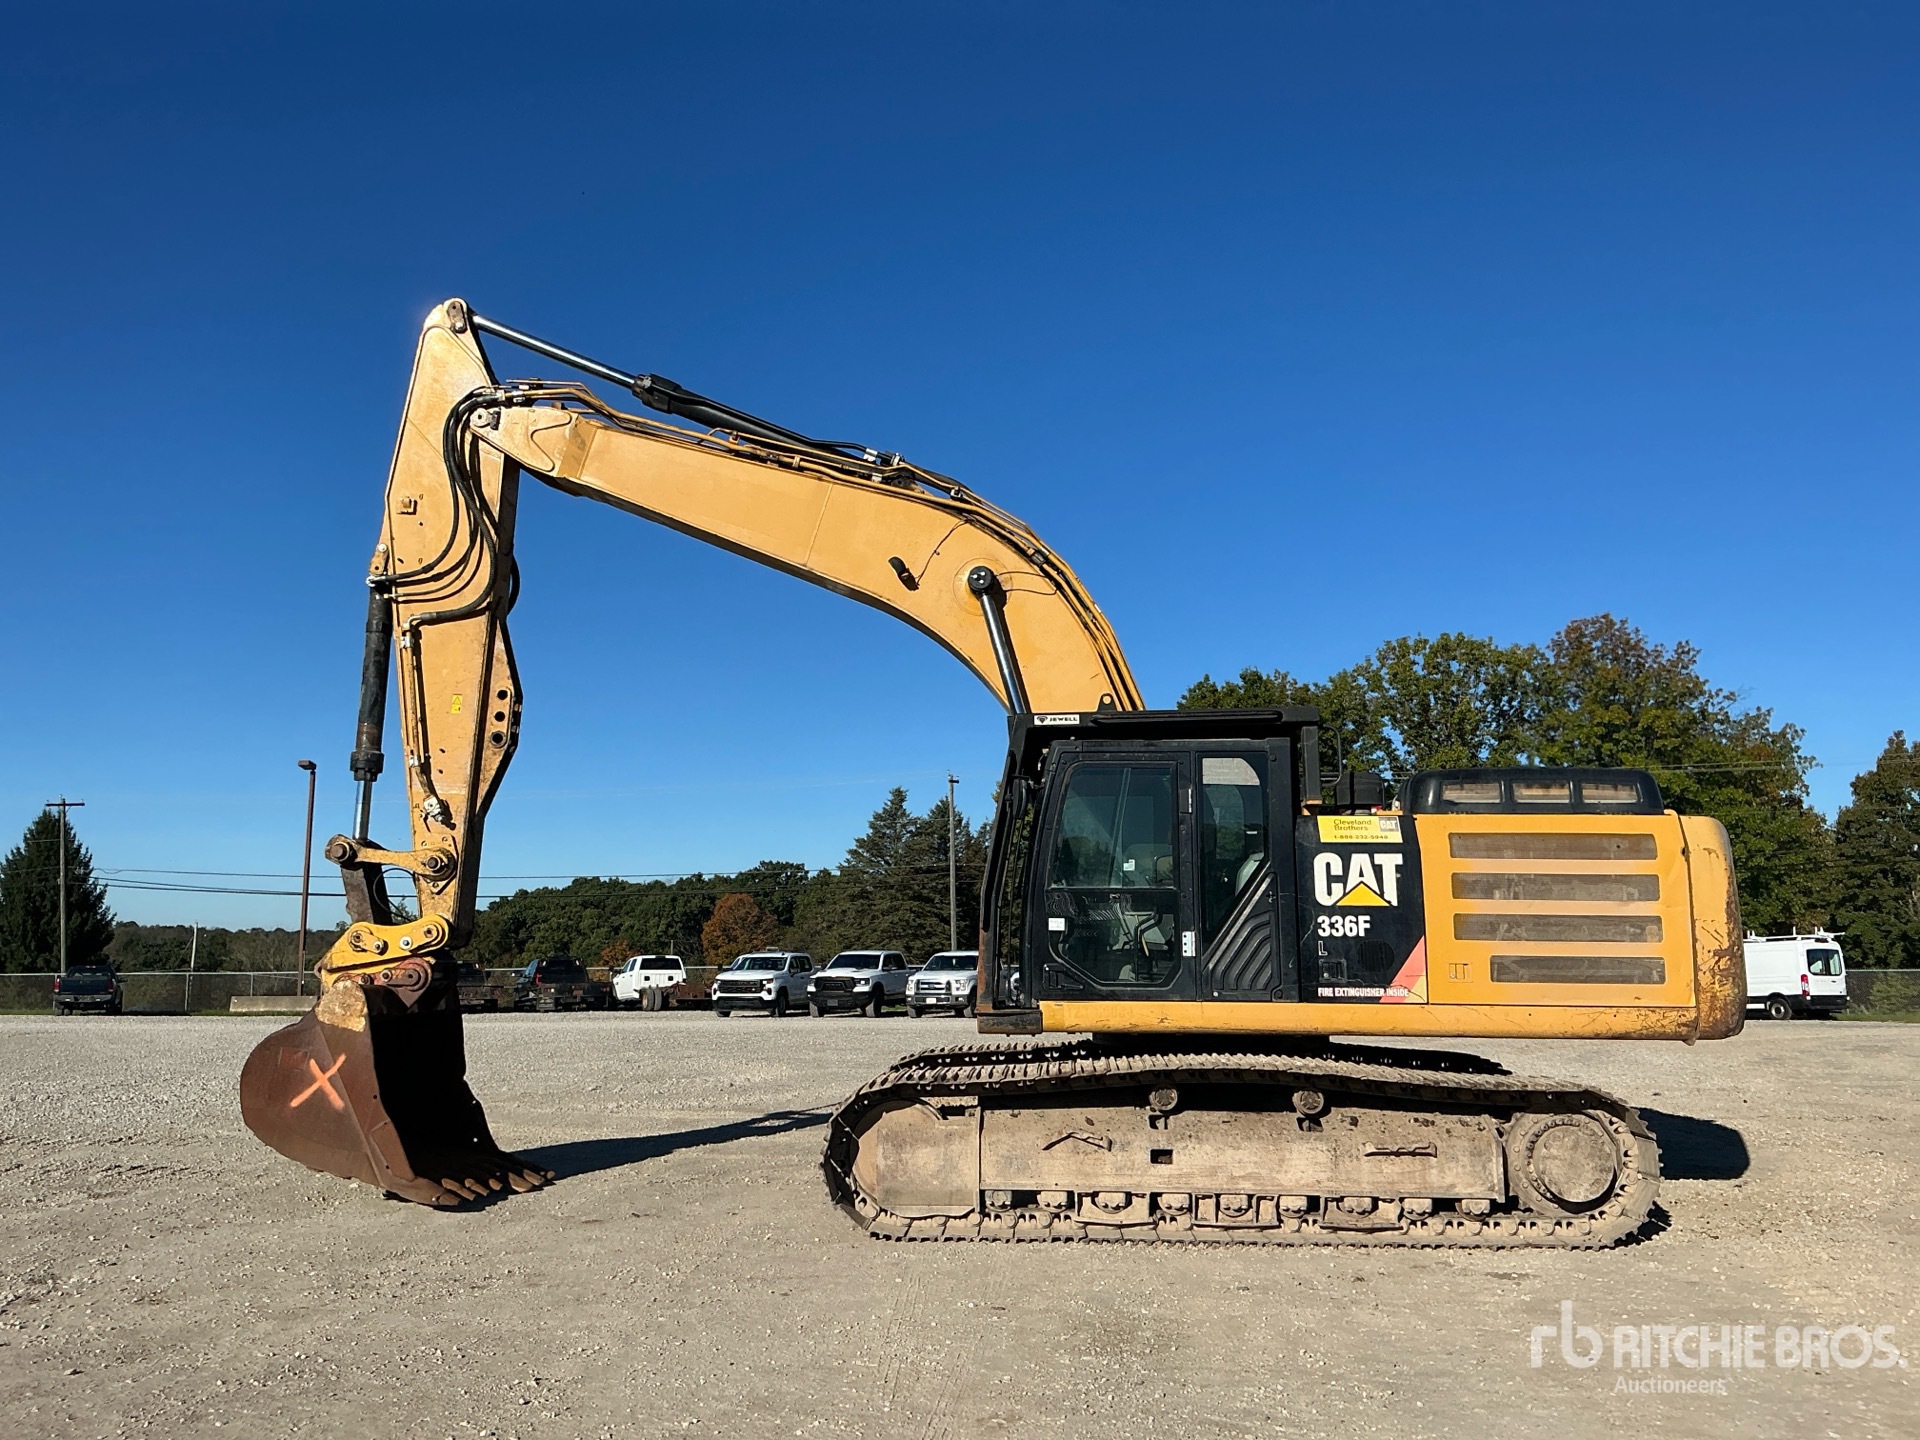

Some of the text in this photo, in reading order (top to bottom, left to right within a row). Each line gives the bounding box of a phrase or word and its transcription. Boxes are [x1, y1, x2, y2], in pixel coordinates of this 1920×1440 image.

[1313, 852, 1403, 906] CAT
[1317, 915, 1371, 937] 336F
[1317, 987, 1409, 997] FIRE EXTINGUISHER INSIDE
